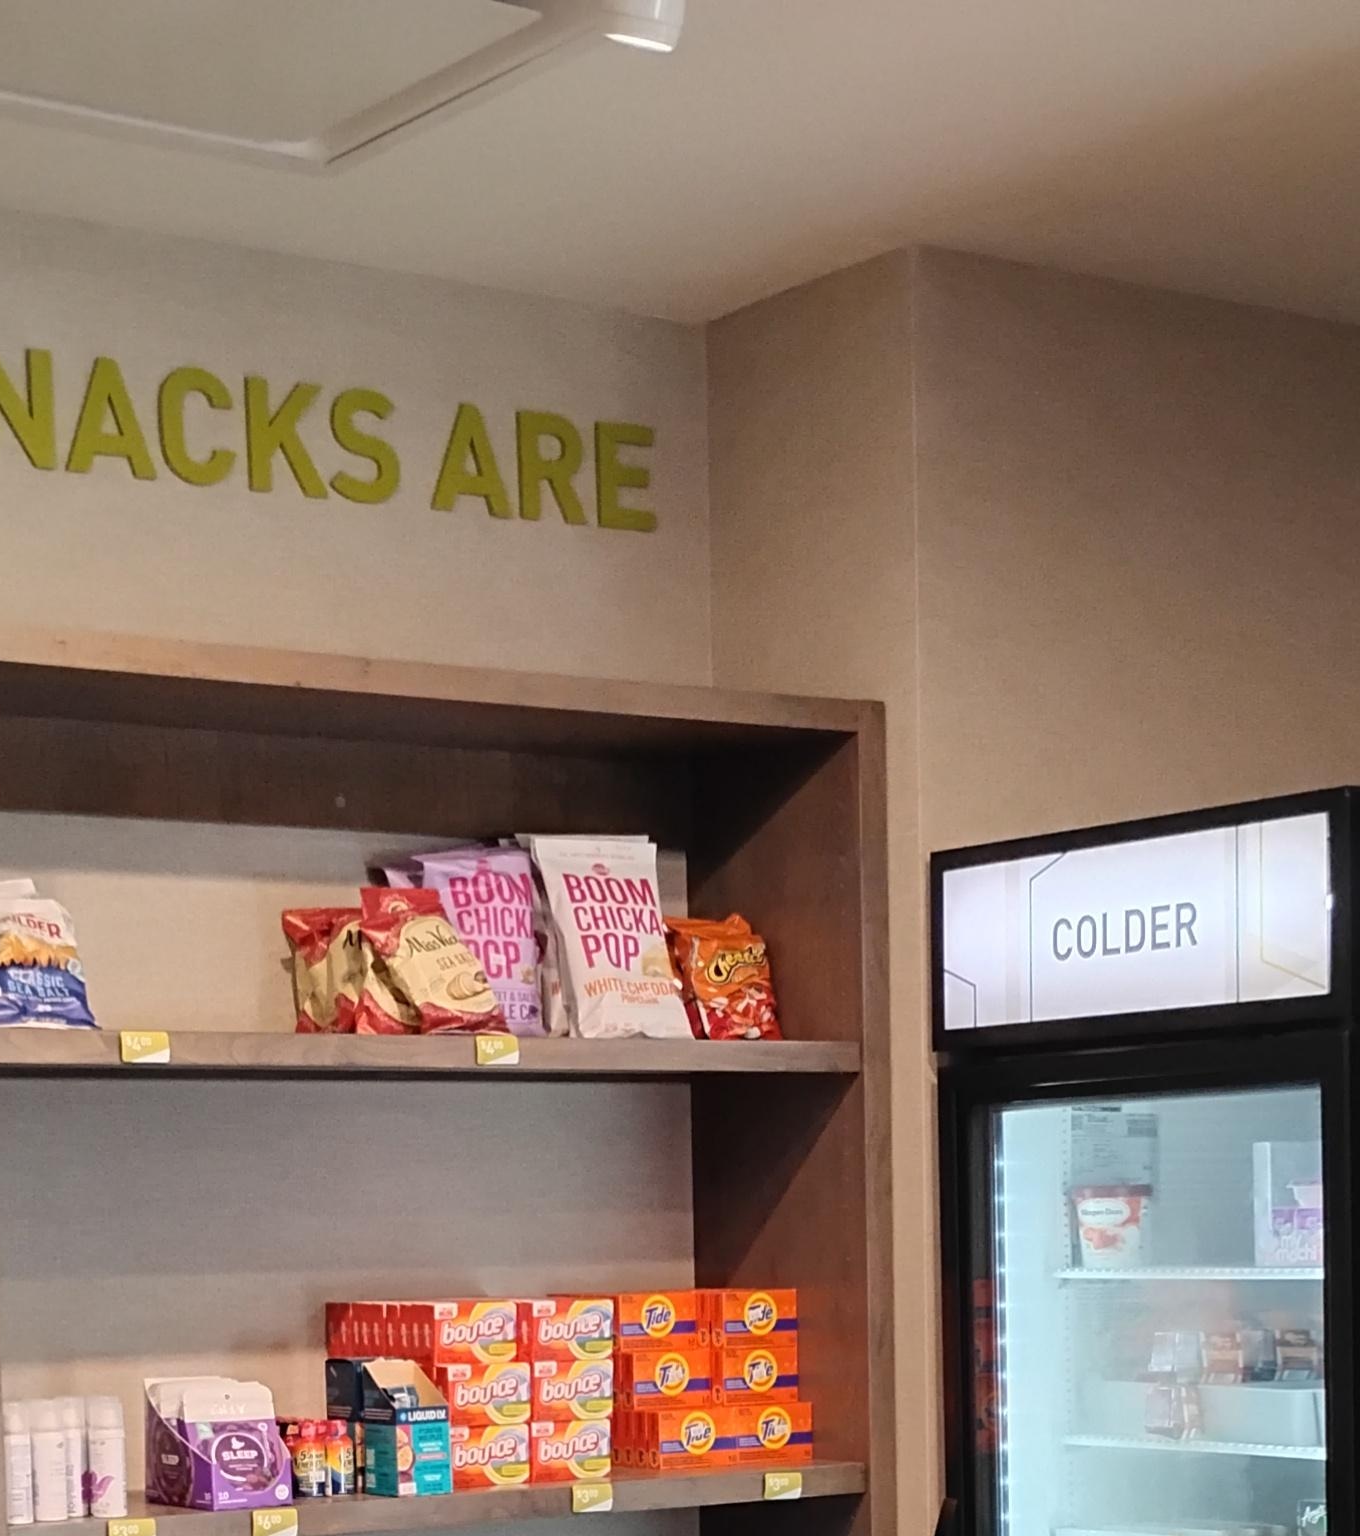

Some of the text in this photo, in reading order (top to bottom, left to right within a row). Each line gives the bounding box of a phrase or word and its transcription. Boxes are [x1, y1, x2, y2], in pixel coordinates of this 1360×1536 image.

[430, 404, 658, 533] ARE
[449, 870, 534, 908] BOOM
[562, 873, 657, 907] BOOM
[574, 906, 663, 937] CHICKA
[1050, 900, 1201, 961] COLDER
[581, 932, 640, 972] POP
[584, 978, 623, 999] WHITE
[442, 1314, 505, 1346] bounce
[541, 1313, 602, 1342] bounce
[645, 1305, 672, 1329] Tide
[455, 1376, 518, 1409] bounce
[542, 1372, 602, 1402] bounce
[408, 1410, 436, 1421] LIQUID
[222, 1449, 259, 1462] SLEEP
[454, 1436, 517, 1468] bounce
[540, 1432, 599, 1462] bounce
